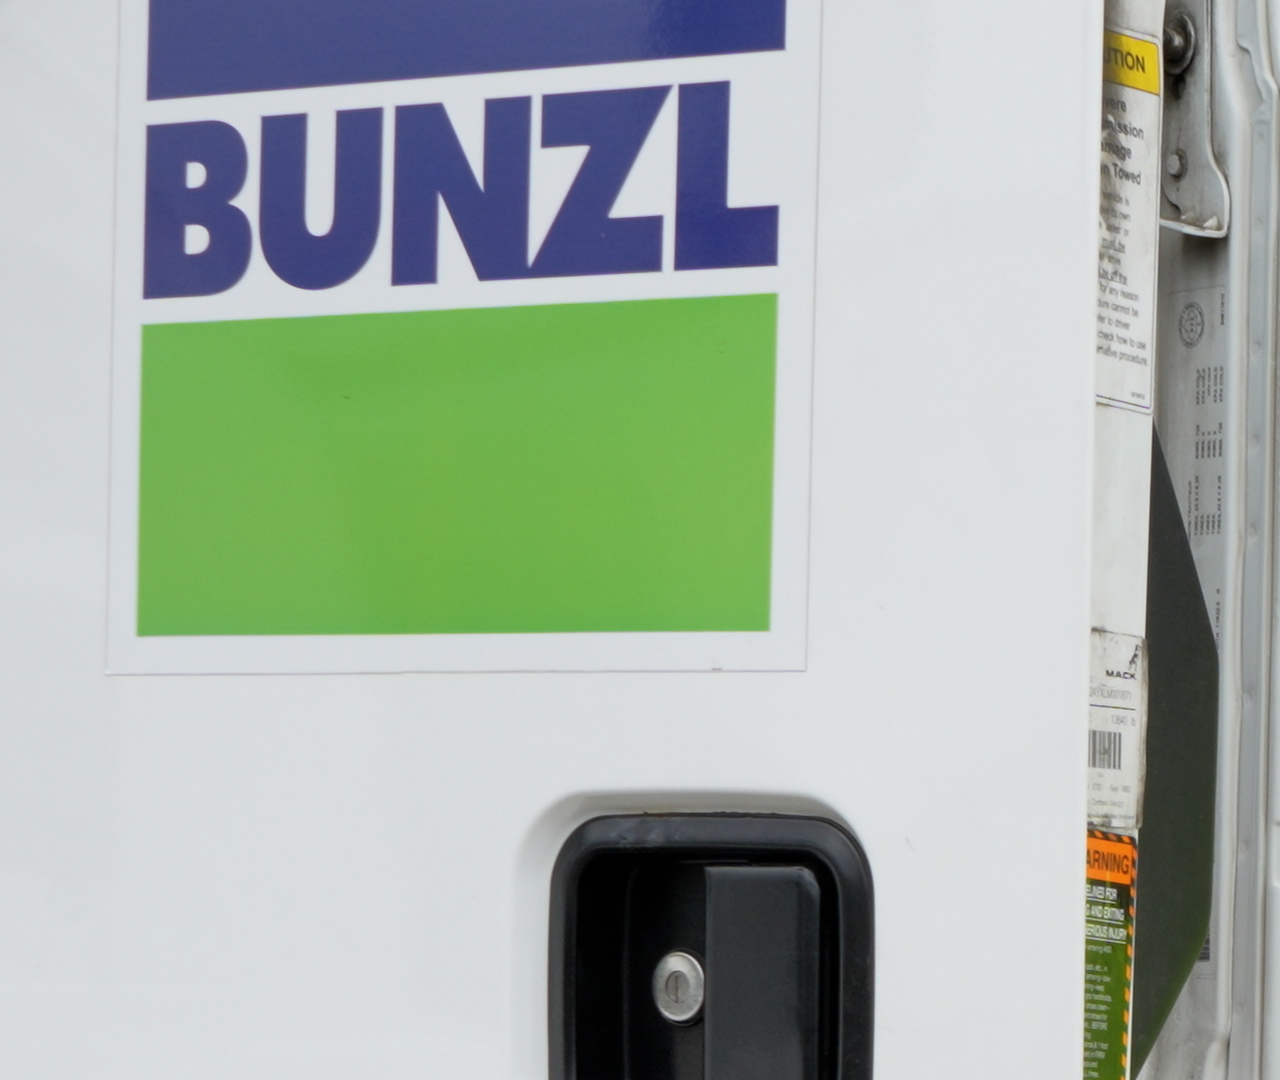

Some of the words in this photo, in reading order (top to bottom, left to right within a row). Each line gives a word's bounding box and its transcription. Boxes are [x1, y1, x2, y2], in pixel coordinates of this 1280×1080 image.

[1112, 162, 1142, 186] Towed
[143, 80, 780, 300] BUNZL
[1105, 669, 1137, 681] MACK
[1087, 849, 1131, 875] ARNING
